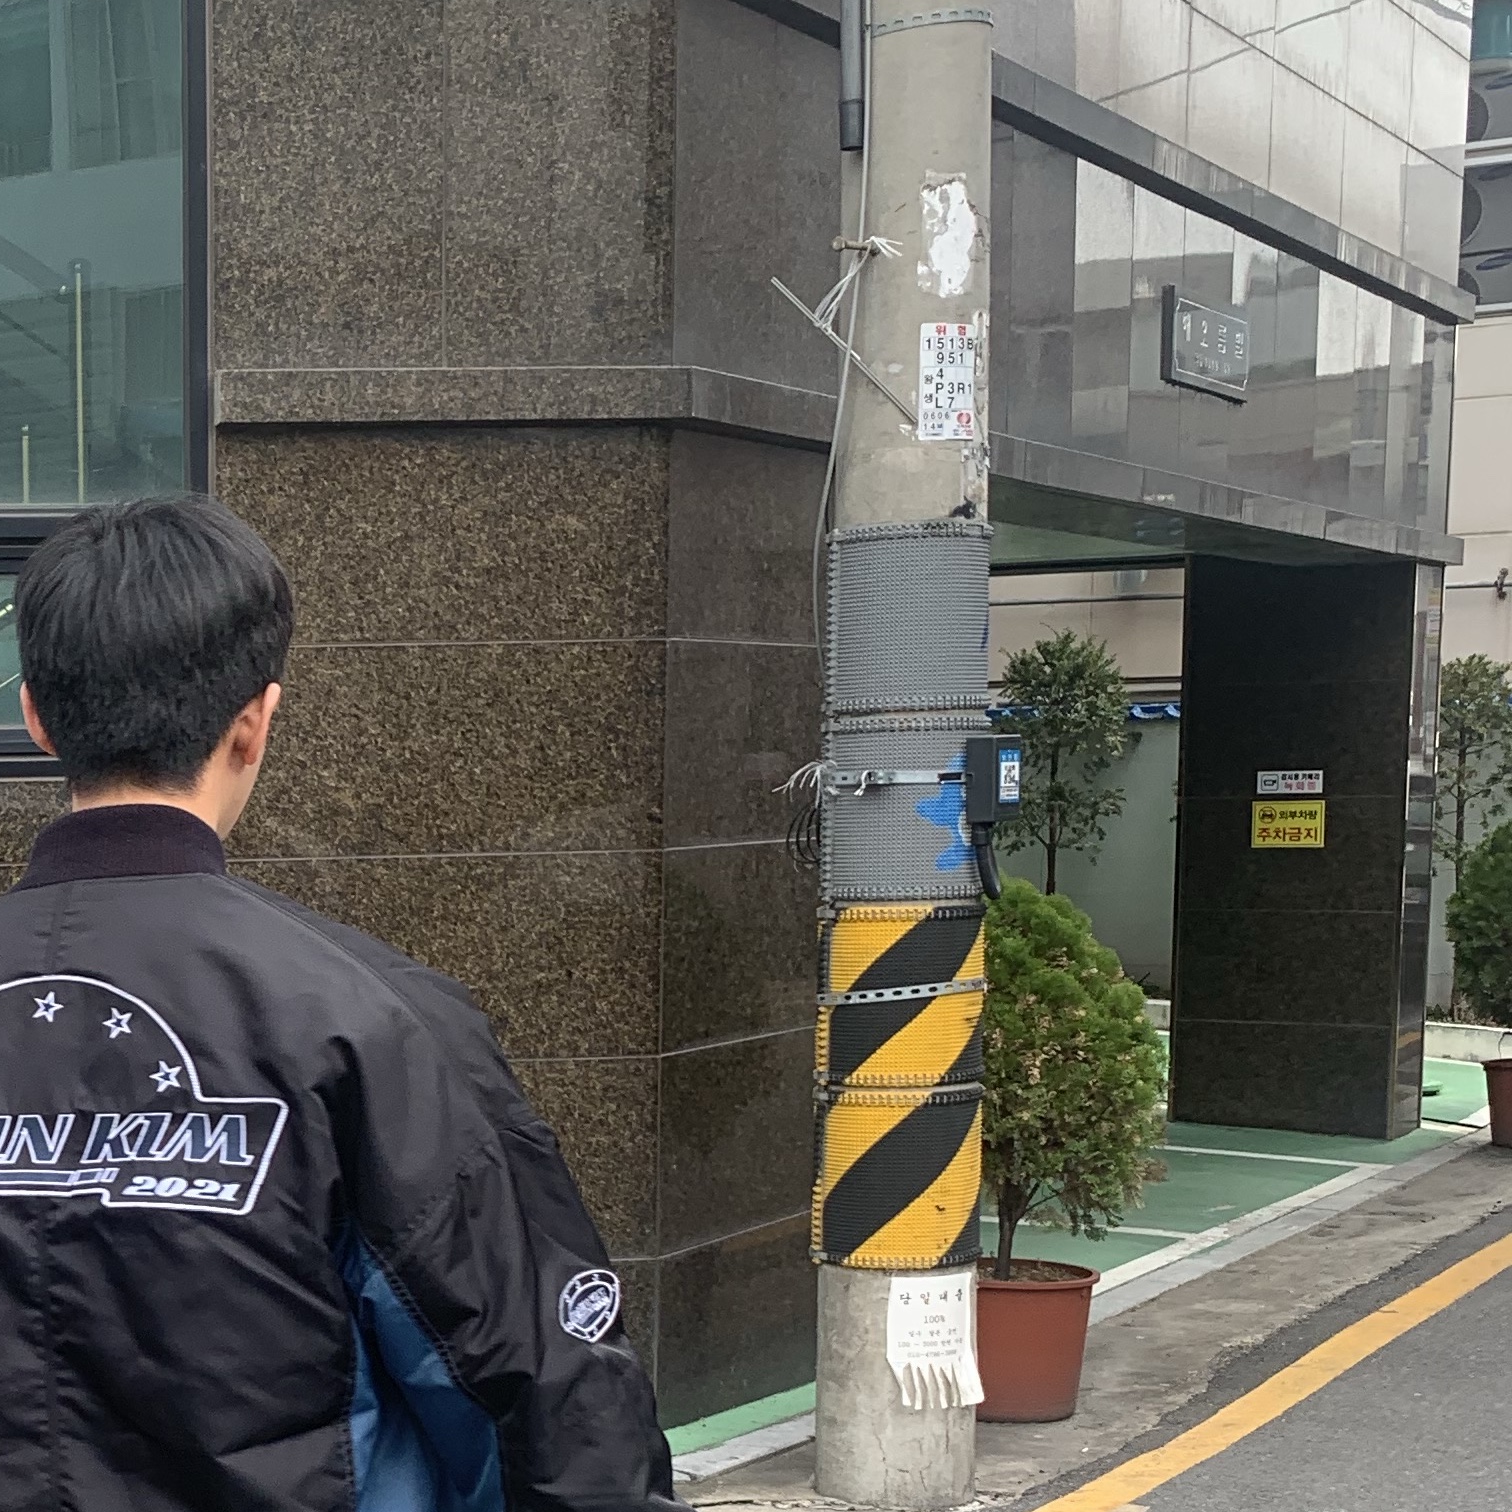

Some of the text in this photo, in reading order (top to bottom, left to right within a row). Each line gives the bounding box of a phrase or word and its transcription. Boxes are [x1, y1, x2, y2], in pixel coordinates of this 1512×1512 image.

[935, 324, 966, 336] 위험
[936, 352, 964, 364] 951
[1278, 809, 1318, 820] 외부차량
[1256, 826, 1318, 842] 주차금지
[79, 1111, 255, 1167] KIM
[121, 1175, 241, 1201] 2021
